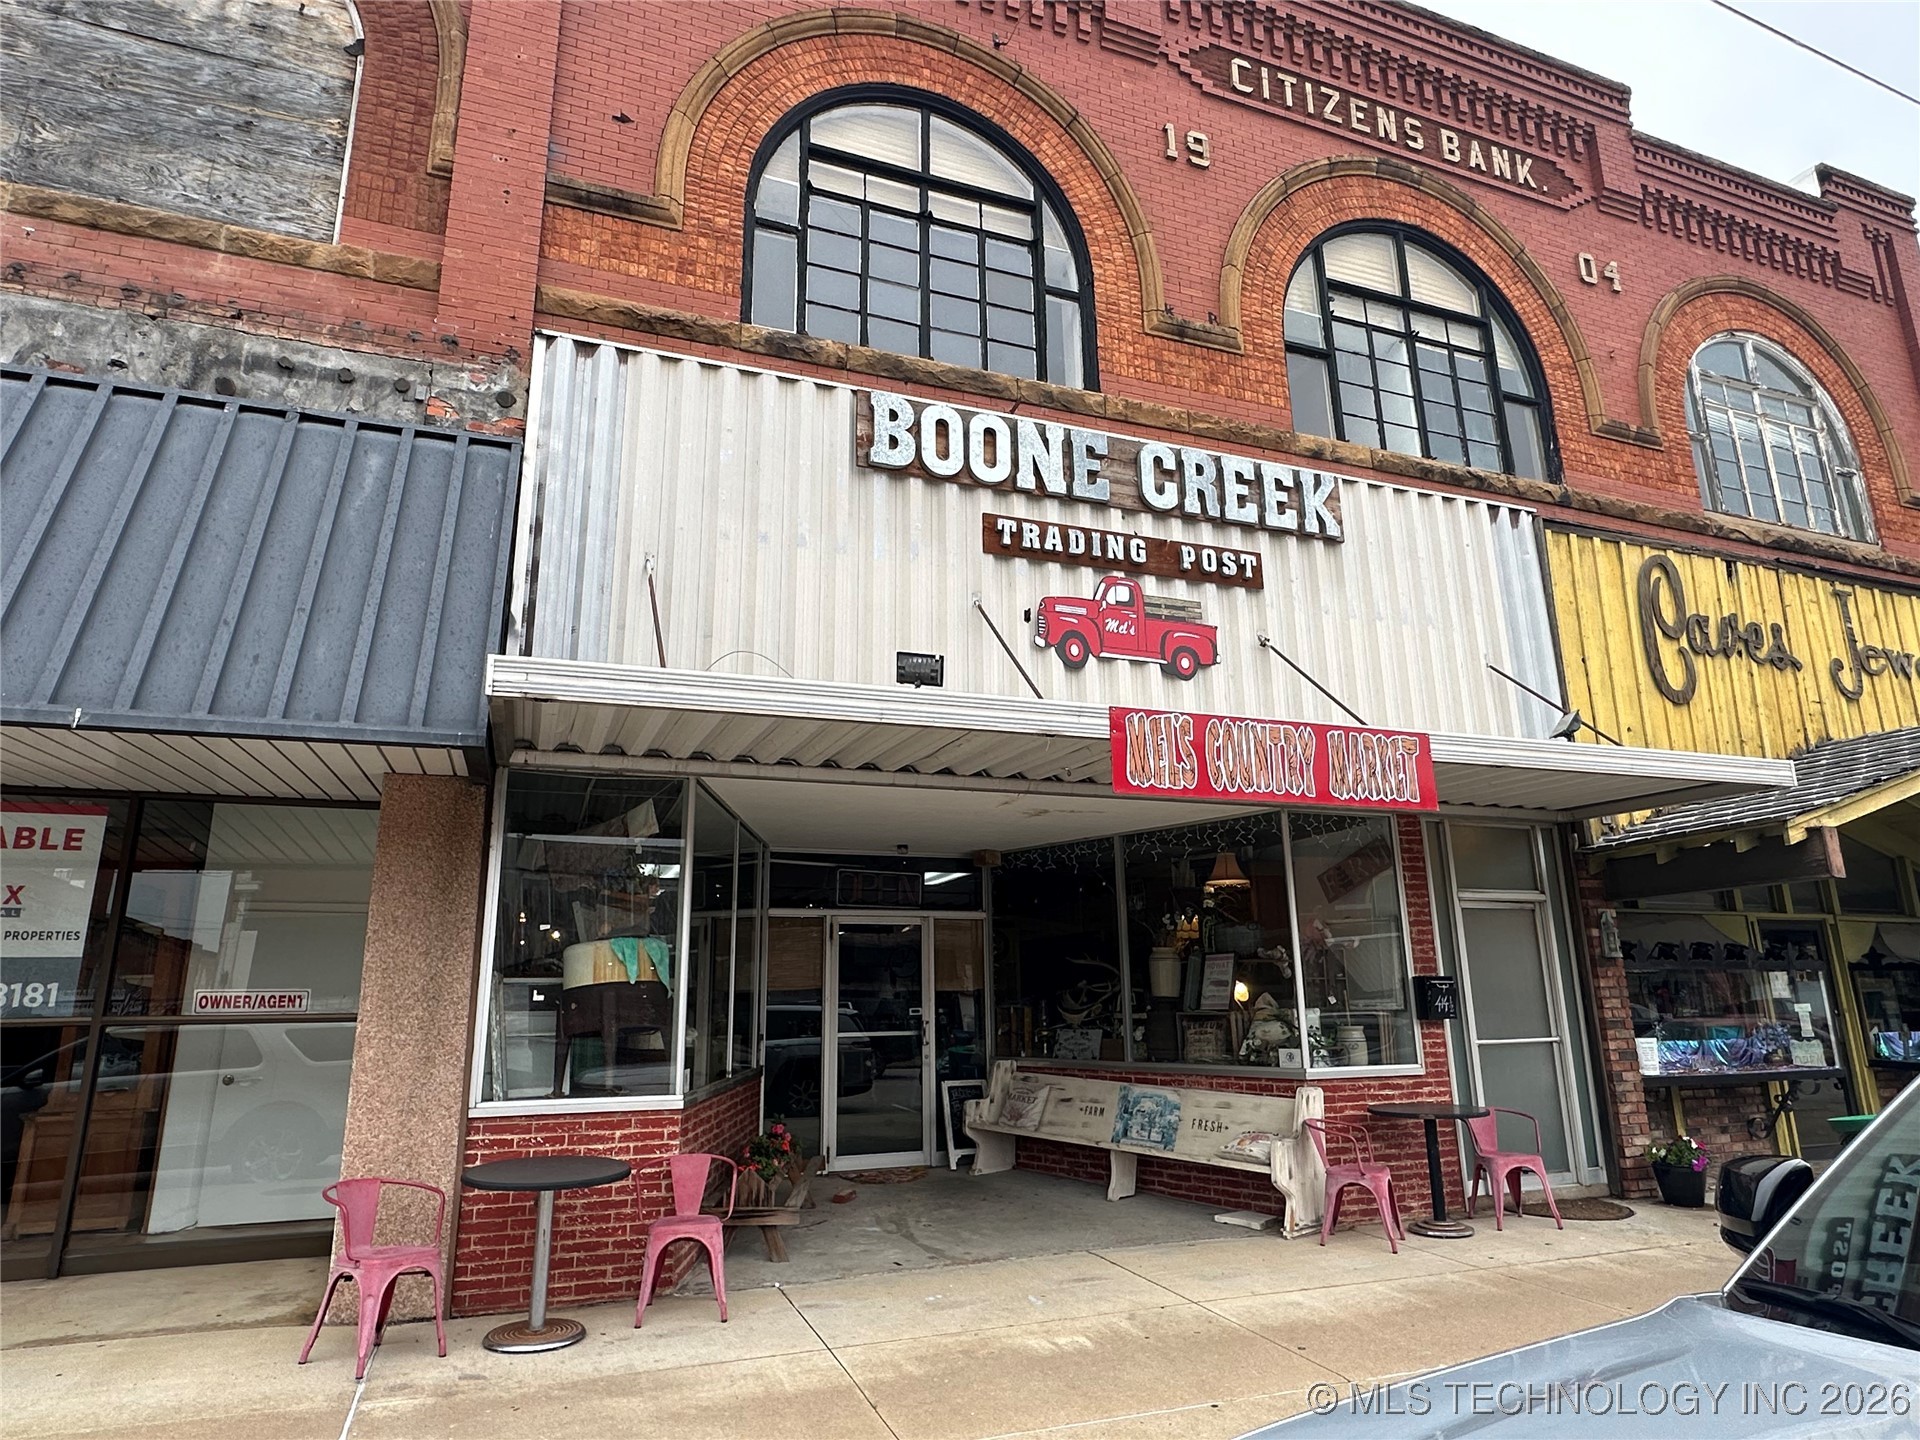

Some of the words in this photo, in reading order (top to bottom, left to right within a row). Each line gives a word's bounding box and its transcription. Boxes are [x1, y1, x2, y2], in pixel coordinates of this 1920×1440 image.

[1229, 56, 1425, 151] CITIZENS
[1162, 121, 1211, 168] 19
[1577, 251, 1623, 292] 04
[867, 390, 1111, 503] BOONE
[1137, 442, 1343, 540] CREEK
[996, 517, 1148, 564] TRADING
[1181, 545, 1258, 580] POST
[1105, 618, 1136, 636] Mel's
[1829, 584, 1920, 701] Jew
[1125, 711, 1198, 790] MEL'S
[1206, 718, 1316, 798] COUNTRY
[1328, 729, 1420, 803] MARKET
[839, 872, 920, 905] OPEN
[4, 930, 81, 941] PROPERTIES
[198, 994, 304, 1010] OWNER/AGENT
[1084, 1105, 1105, 1117] FARM
[1191, 1118, 1223, 1133] FRESH
